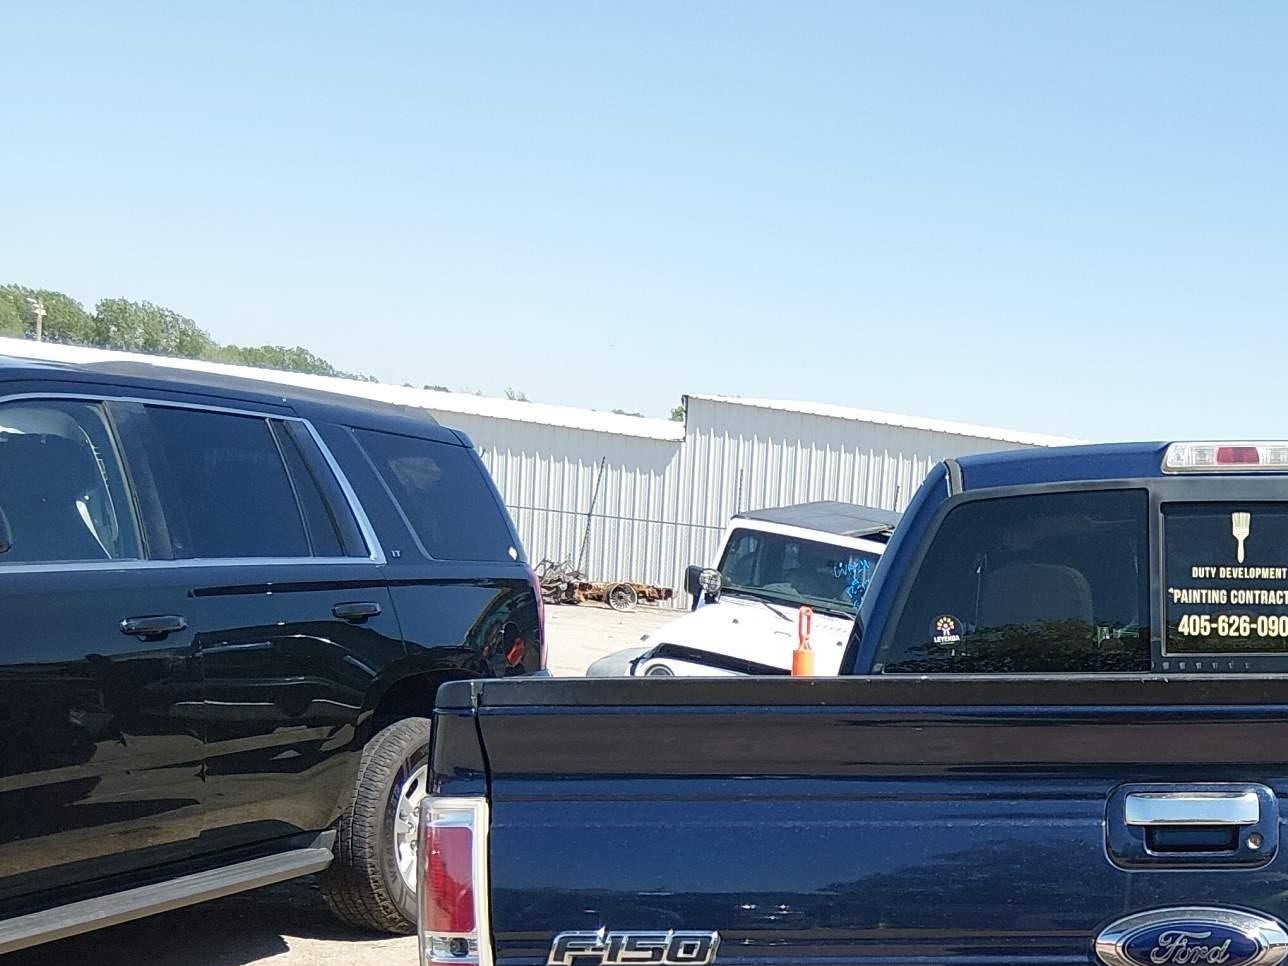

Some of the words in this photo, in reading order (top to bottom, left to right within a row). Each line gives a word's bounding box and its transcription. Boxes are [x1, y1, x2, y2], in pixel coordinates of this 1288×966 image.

[1191, 566, 1217, 579] DUTY
[1219, 567, 1288, 580] DEVELOPMENT
[1173, 589, 1228, 604] PAINTING
[1150, 930, 1232, 965] Ford
